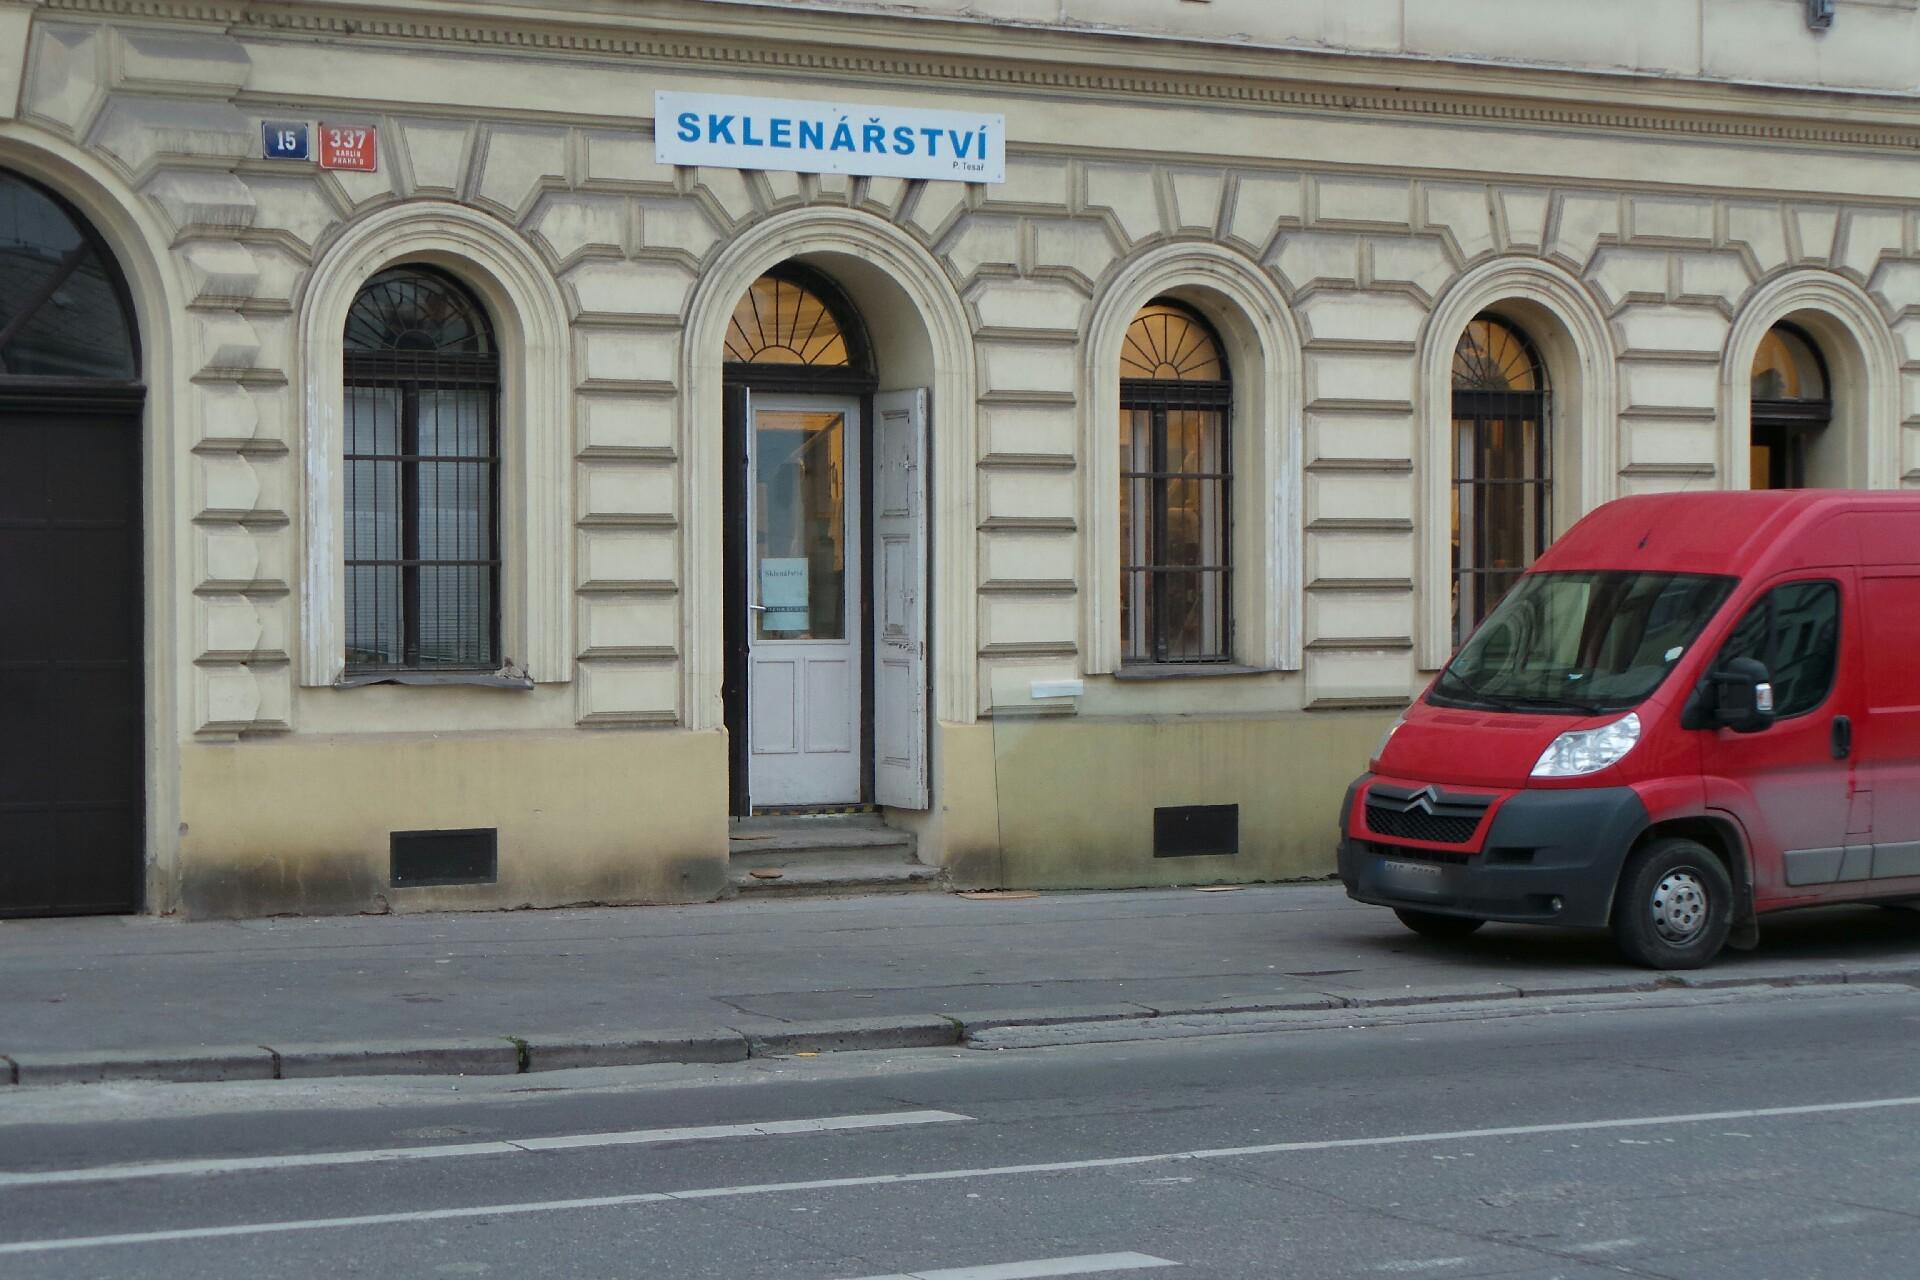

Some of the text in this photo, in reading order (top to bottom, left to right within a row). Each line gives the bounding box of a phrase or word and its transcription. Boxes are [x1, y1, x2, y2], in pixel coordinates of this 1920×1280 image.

[277, 131, 296, 150] 15
[330, 129, 366, 149] 337
[677, 112, 986, 160] SKLENÁŘSTVÍ
[952, 161, 961, 169] P.
